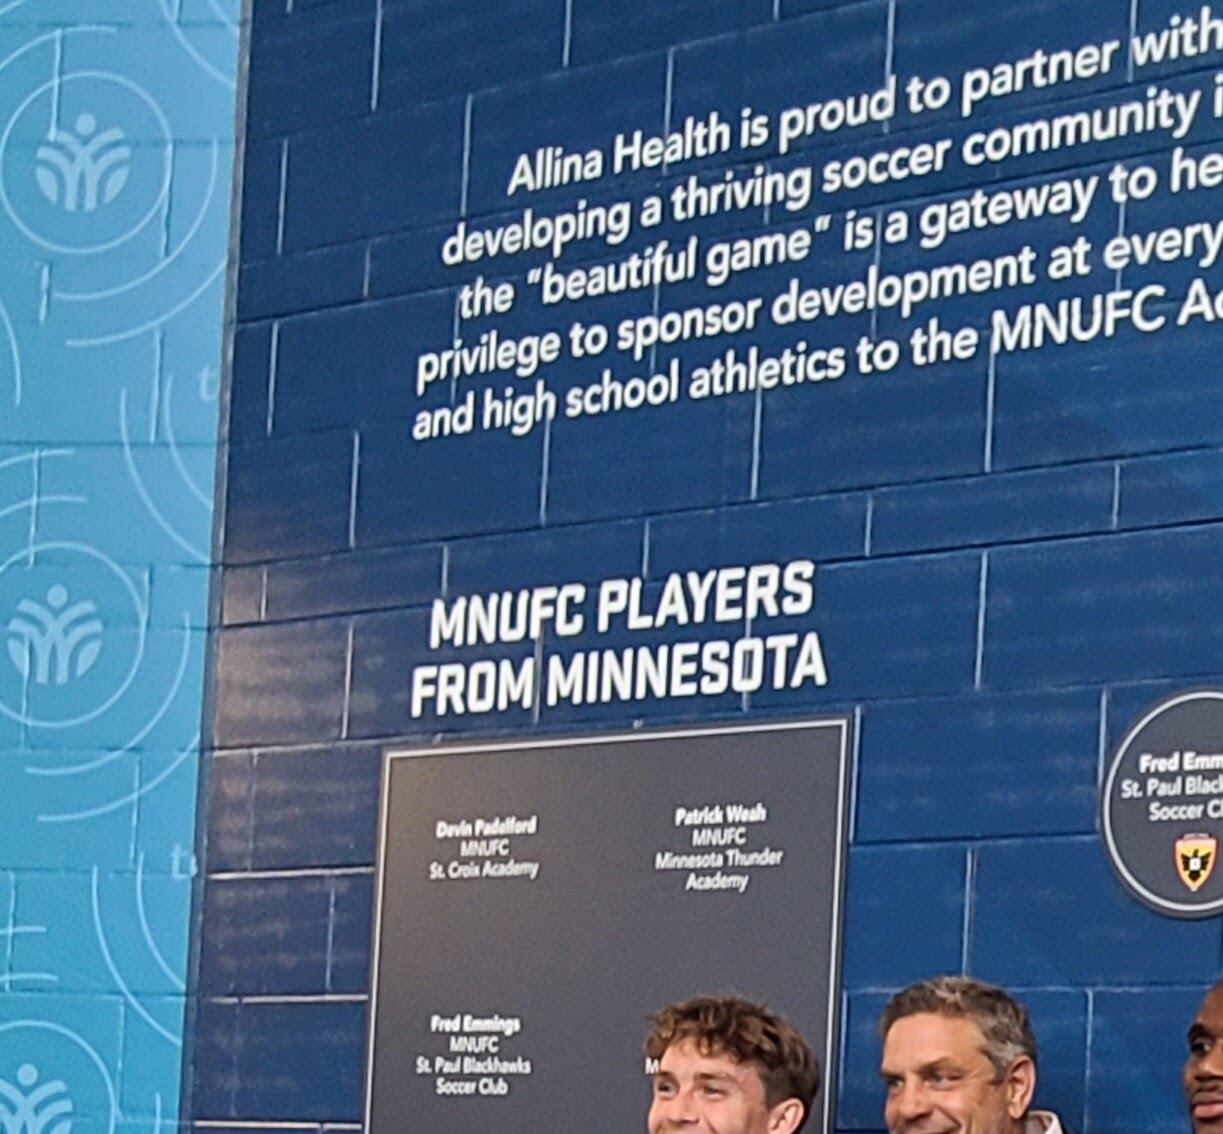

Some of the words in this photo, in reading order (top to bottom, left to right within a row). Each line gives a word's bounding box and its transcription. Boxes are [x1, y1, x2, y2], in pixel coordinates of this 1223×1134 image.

[507, 147, 602, 196] Allina
[614, 111, 730, 174] Health
[740, 107, 769, 149] is
[778, 75, 896, 154] proud
[906, 76, 951, 113] to
[961, 40, 1120, 117] partner
[442, 199, 631, 265] developing
[640, 196, 662, 228] a
[671, 165, 812, 222] thriving
[822, 138, 952, 193] soccer
[962, 86, 1200, 165] community
[460, 276, 514, 319] the
[844, 210, 873, 251] is
[885, 211, 908, 243] a
[920, 174, 1098, 248] gateway
[1109, 163, 1157, 202] to
[417, 330, 561, 395] privilege
[569, 323, 608, 358] to
[617, 298, 762, 361] sponsor
[771, 246, 1036, 324] development
[1048, 237, 1092, 280] at
[412, 391, 474, 440] and
[482, 380, 556, 436] high
[565, 359, 679, 417] school
[689, 341, 845, 399] athletics
[856, 335, 899, 375] to
[909, 318, 978, 366] the
[990, 285, 1166, 354] MNUFC
[429, 583, 587, 650] MNUFC
[598, 559, 816, 632] PLAYERS
[410, 656, 535, 719] FROM
[546, 631, 829, 707] MINNESOTA
[1139, 751, 1180, 773] Fred
[1121, 779, 1143, 799] St.
[1147, 775, 1182, 797] Paul
[675, 805, 723, 826] Patrick
[726, 802, 767, 823] Weah
[1149, 802, 1203, 821] Soccer
[435, 820, 473, 838] Devin
[692, 826, 747, 847] MNUFC
[460, 838, 510, 856] MNUFC
[655, 851, 723, 869] Minnesota
[725, 846, 784, 866] Thunder
[429, 861, 446, 879] St.
[447, 861, 480, 879] Croix
[482, 859, 539, 880] Academy
[685, 871, 749, 893] Academy
[431, 1014, 460, 1032] Fred
[463, 1014, 520, 1036] Emmings
[450, 1036, 499, 1053] MNUFC
[416, 1056, 432, 1073] St.
[435, 1056, 460, 1073] Paul
[463, 1056, 531, 1074] Blackhawks
[436, 1077, 476, 1094] Soccer
[478, 1077, 508, 1095] Club
